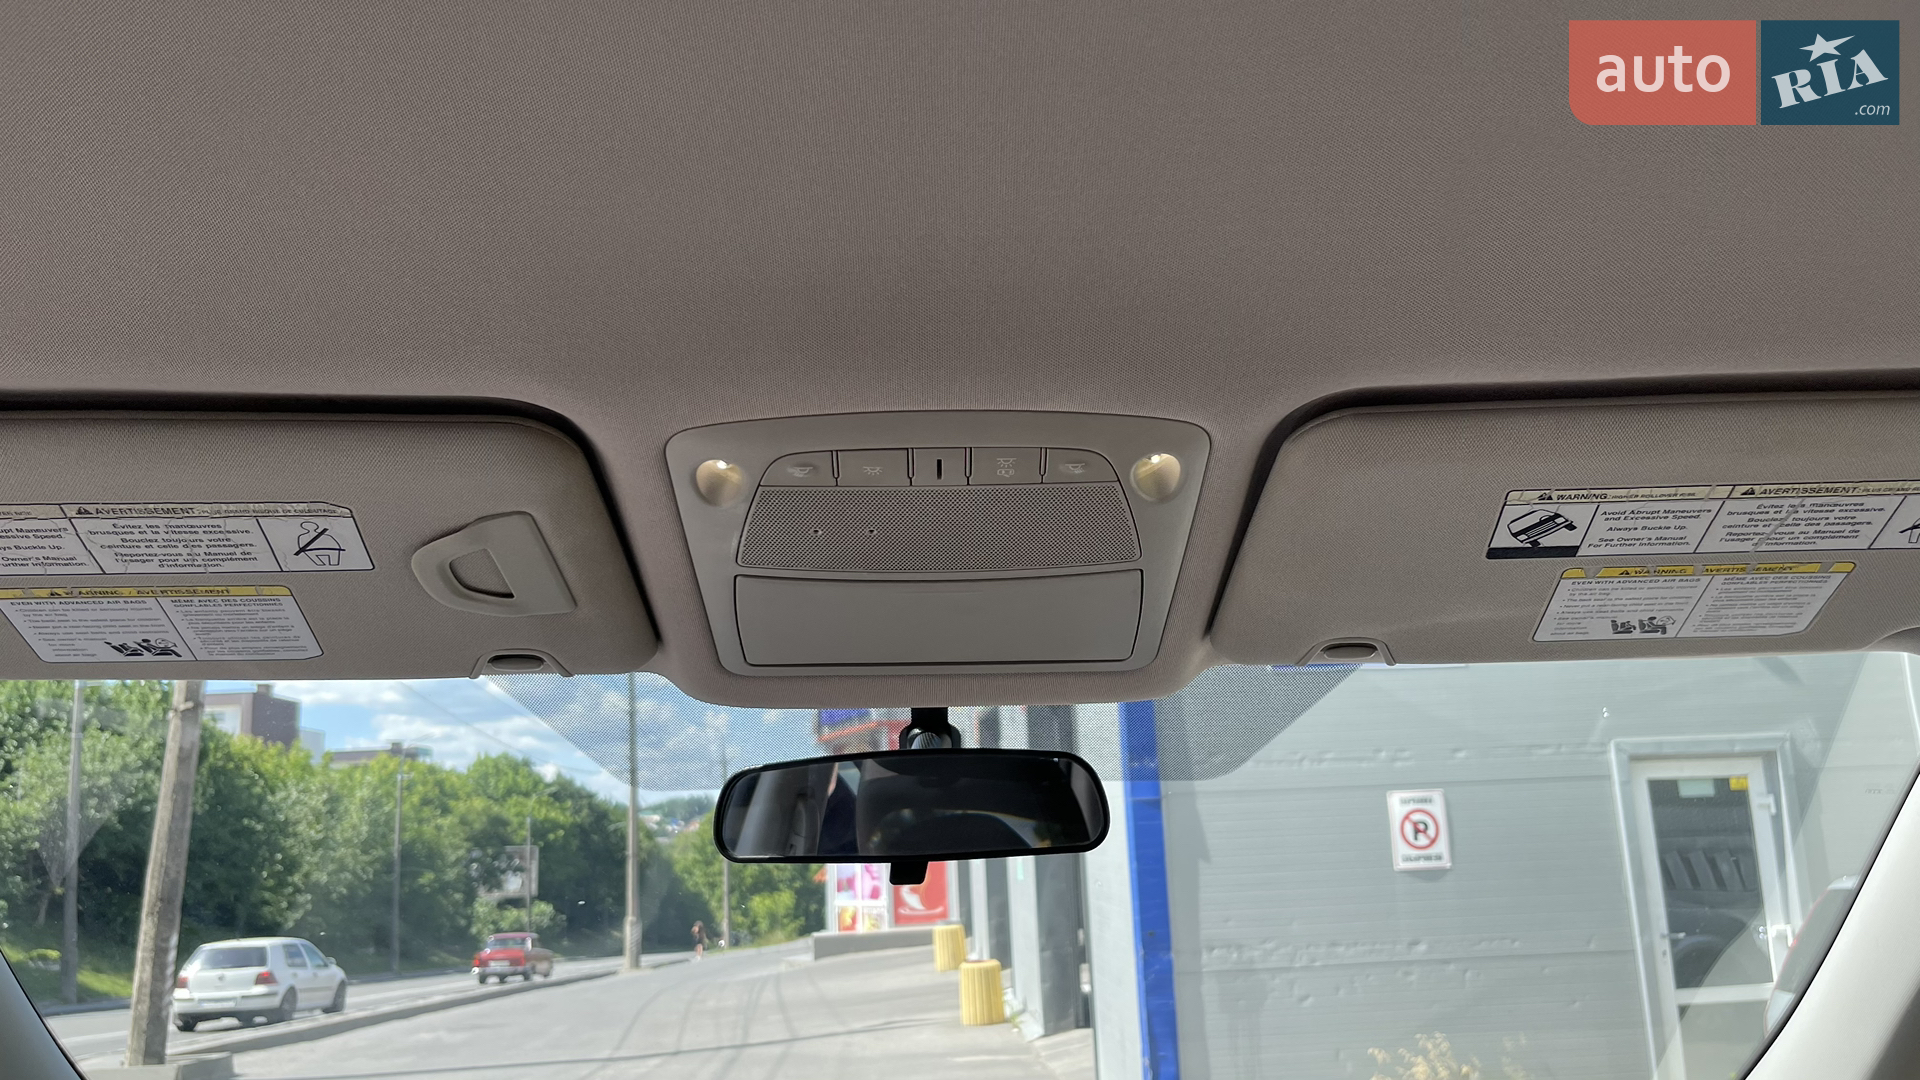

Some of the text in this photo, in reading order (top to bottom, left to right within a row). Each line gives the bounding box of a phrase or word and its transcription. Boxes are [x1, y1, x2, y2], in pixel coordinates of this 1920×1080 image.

[1628, 509, 1660, 517] Abrupt
[1671, 514, 1702, 522] Speed.
[1792, 515, 1830, 523] toujours
[1819, 520, 1873, 528] passagers.
[1606, 525, 1639, 533] Always
[1674, 524, 1688, 532] Up.
[33, 533, 66, 541] Speed.
[48, 544, 66, 552] Up.
[1603, 541, 1637, 549] Further
